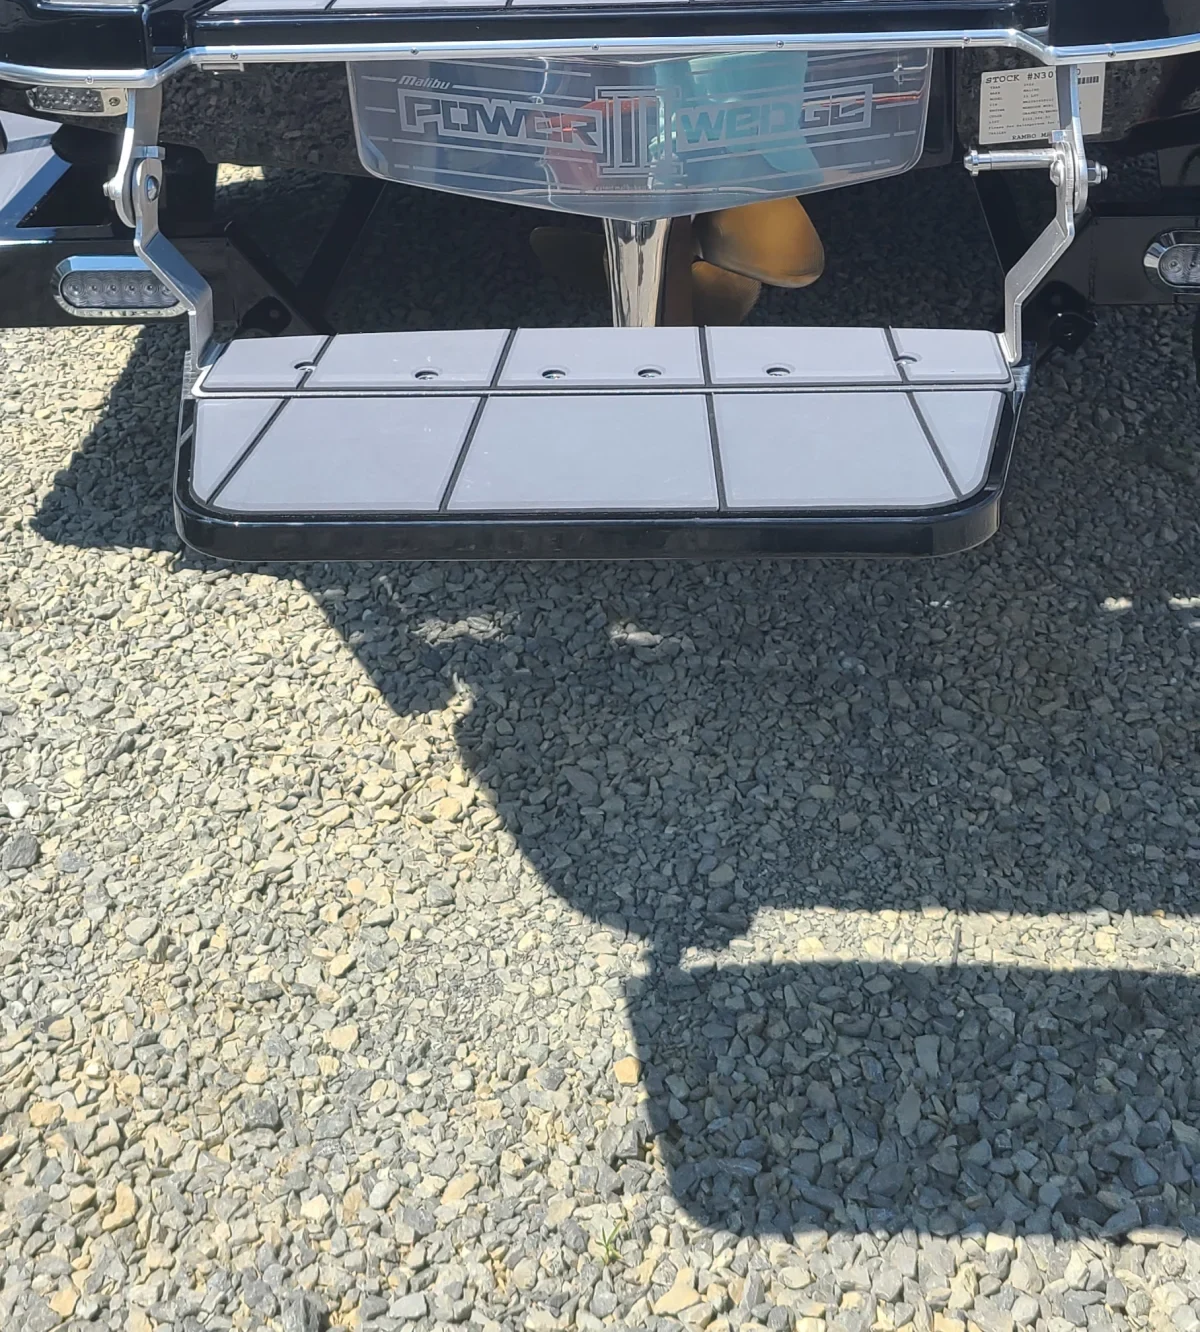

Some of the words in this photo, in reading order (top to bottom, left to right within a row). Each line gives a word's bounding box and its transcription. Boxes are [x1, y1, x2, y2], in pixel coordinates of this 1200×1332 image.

[985, 74, 1020, 84] STOCK
[1027, 70, 1056, 81] #N30
[403, 95, 600, 148] POWER
[677, 86, 869, 146] WEDGE
[1012, 133, 1037, 141] RAMBO
